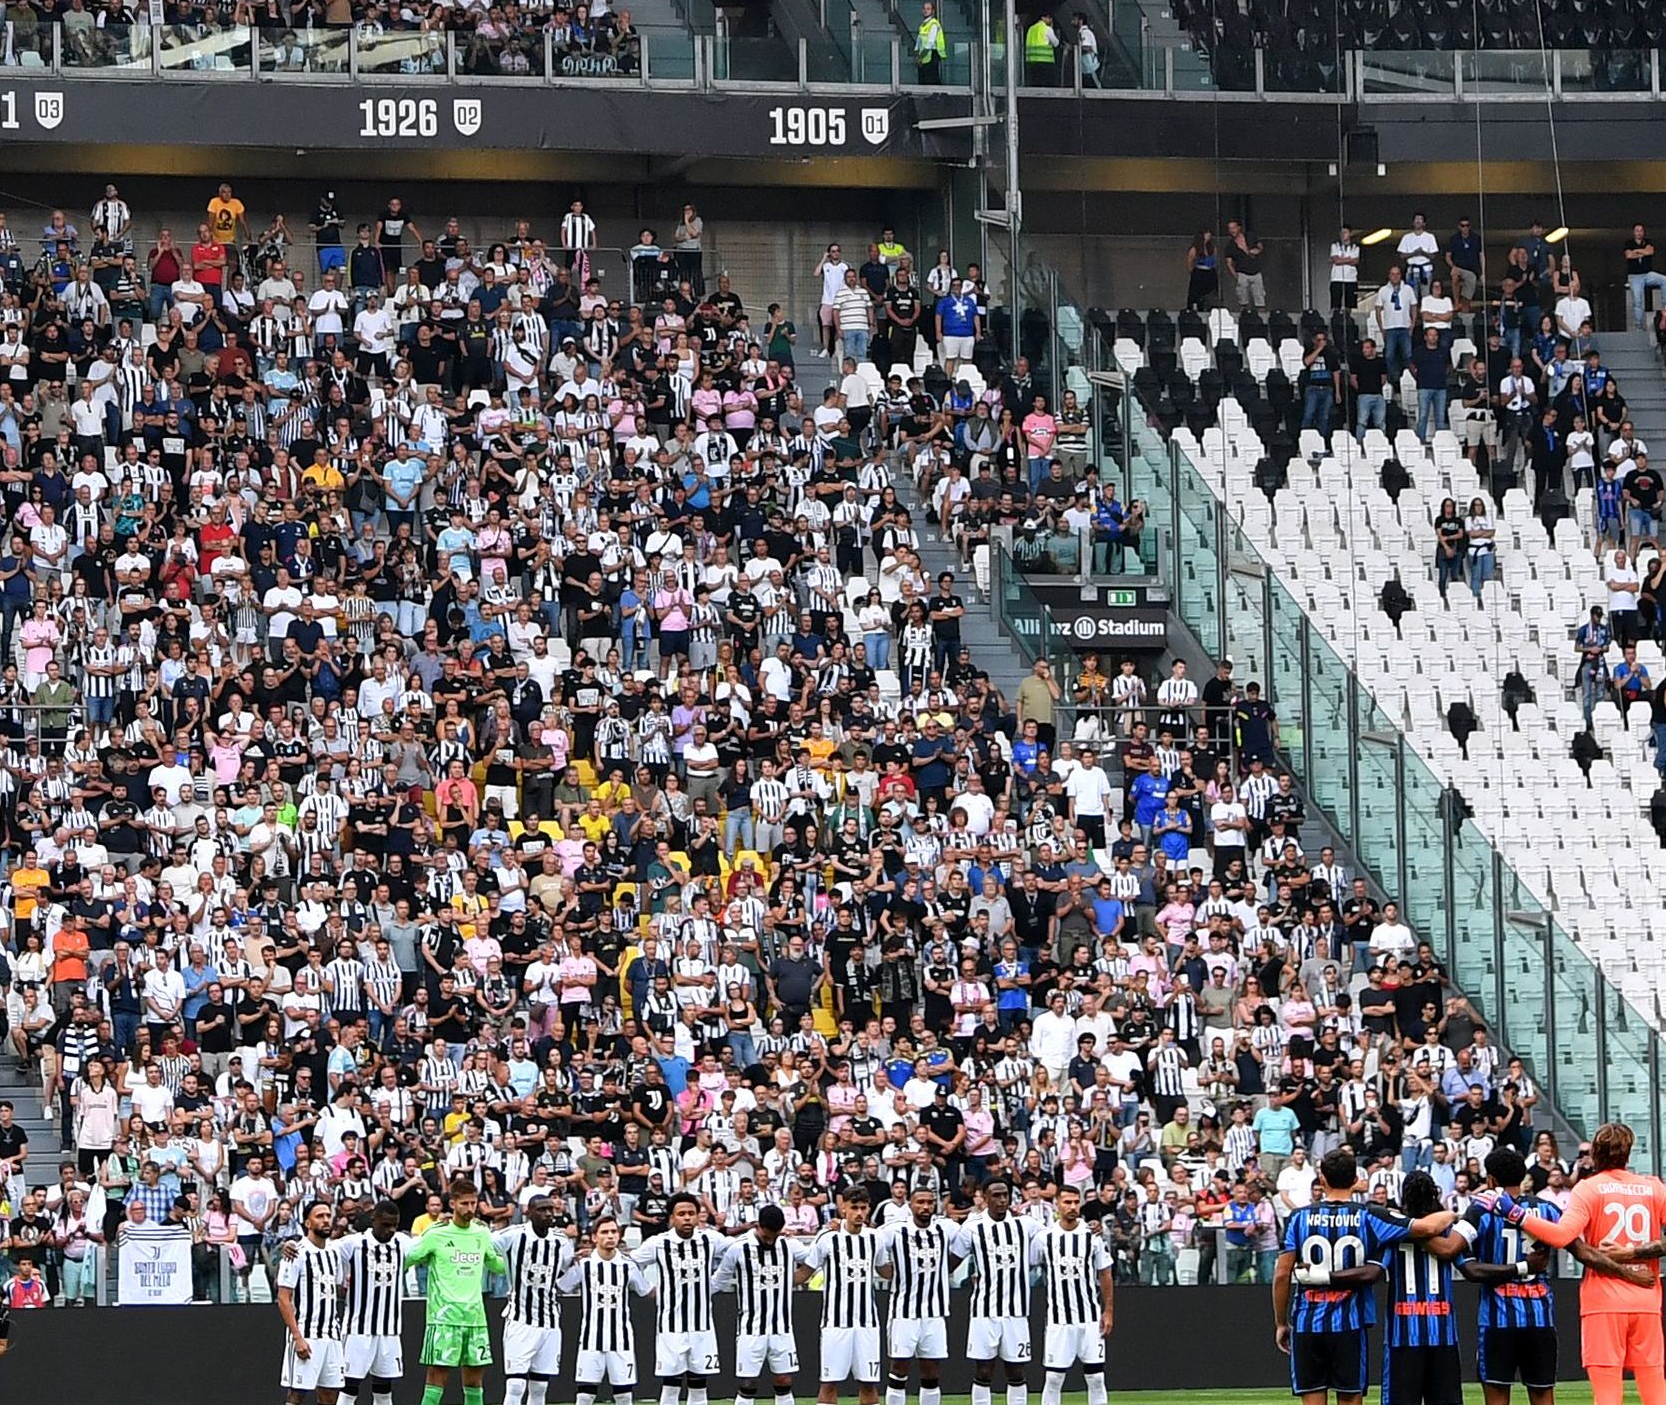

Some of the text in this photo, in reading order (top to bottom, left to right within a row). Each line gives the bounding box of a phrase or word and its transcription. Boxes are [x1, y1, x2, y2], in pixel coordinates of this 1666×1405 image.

[39, 99, 60, 119] 03
[360, 100, 479, 136] 1926 02
[770, 108, 886, 144] 1905 01
[1013, 618, 1165, 636] Allinz Stadium
[1600, 1202, 1651, 1247] 29
[450, 1250, 480, 1265] Jeep
[1302, 1234, 1365, 1274] 90
[754, 1265, 785, 1278] Jeep
[1398, 1243, 1440, 1295] 11
[1395, 1301, 1451, 1316] GEWISS
[705, 1354, 719, 1370] 22
[868, 1361, 880, 1377] 17
[627, 1364, 633, 1379] 7
